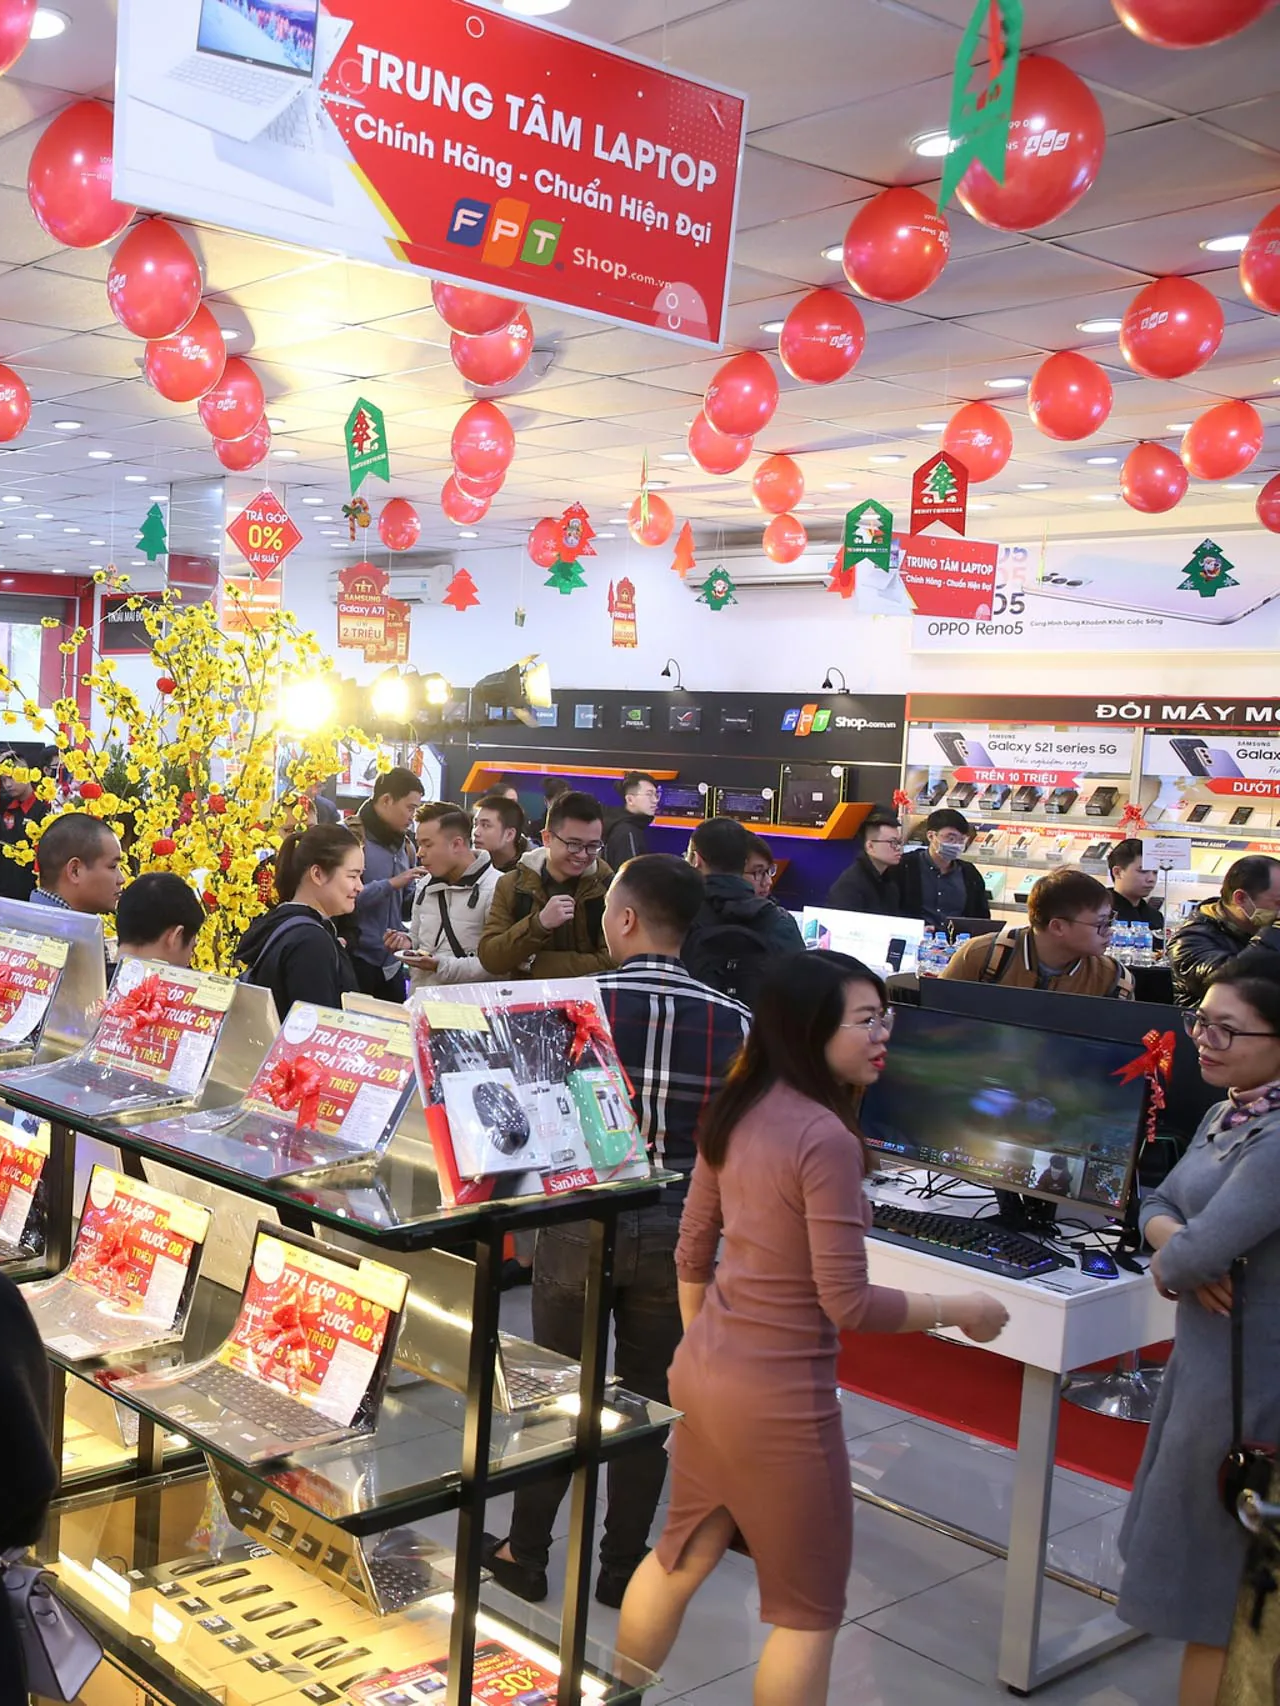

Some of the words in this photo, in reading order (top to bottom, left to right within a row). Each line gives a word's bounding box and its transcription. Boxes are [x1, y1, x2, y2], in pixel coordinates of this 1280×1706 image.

[357, 45, 494, 120] TRUNG
[505, 93, 582, 151] TÂM
[594, 124, 717, 192] LAPTOP
[1023, 130, 1071, 157] FPT
[354, 113, 435, 159] Chính
[534, 168, 613, 214] Chuẩn
[620, 193, 670, 233] Hiện
[675, 211, 712, 248] Đại
[450, 203, 560, 260] FPT
[572, 247, 673, 290] Shop.com.vn
[245, 508, 264, 522] TRẢ
[266, 509, 288, 525] GÓP
[247, 524, 284, 550] 0%
[249, 553, 261, 563] LÃI
[906, 556, 937, 570] TRUNG
[939, 558, 959, 573] TÂM
[961, 561, 993, 576] LAPTOP
[354, 580, 372, 593] TẾT
[344, 593, 381, 604] SAMSUNG
[339, 604, 369, 617] Galaxy
[370, 604, 385, 615] A71
[342, 628, 350, 639] 2
[351, 627, 382, 642] TRIỆU
[928, 621, 970, 636] OPPO
[975, 621, 1024, 635] Reno5
[783, 711, 828, 730] FPT
[1161, 702, 1236, 721] MÁY
[987, 741, 1032, 754] Galaxy
[1034, 742, 1054, 753] S21
[1056, 744, 1096, 755] series
[1099, 744, 1117, 755] 5G
[974, 770, 1005, 782] TRÊN
[1008, 772, 1020, 782] 10
[1023, 771, 1057, 784] TRIỆU
[1233, 781, 1271, 793] DƯỚI
[9, 952, 28, 968] GÓP
[26, 958, 40, 972] 0%
[8, 970, 37, 988] TRƯỚC
[162, 1005, 197, 1025] TRƯỚC
[311, 1030, 337, 1049] TRẢ
[337, 1034, 368, 1054] GÓP
[365, 1043, 386, 1059] 0%
[335, 1054, 382, 1078] TRƯỚC
[329, 1075, 359, 1095] TRIỆU
[549, 1170, 591, 1193] SanDisk
[154, 1213, 170, 1231] 0%
[139, 1227, 170, 1251] RƯỚC
[131, 1246, 156, 1266] TRIỆU
[282, 1267, 308, 1291] TRẢ
[307, 1279, 337, 1301] GÓP
[334, 1291, 358, 1312] 0%
[306, 1327, 336, 1351] TRIỆU
[352, 1324, 373, 1343] 0Đ
[487, 1666, 540, 1697] 30%
